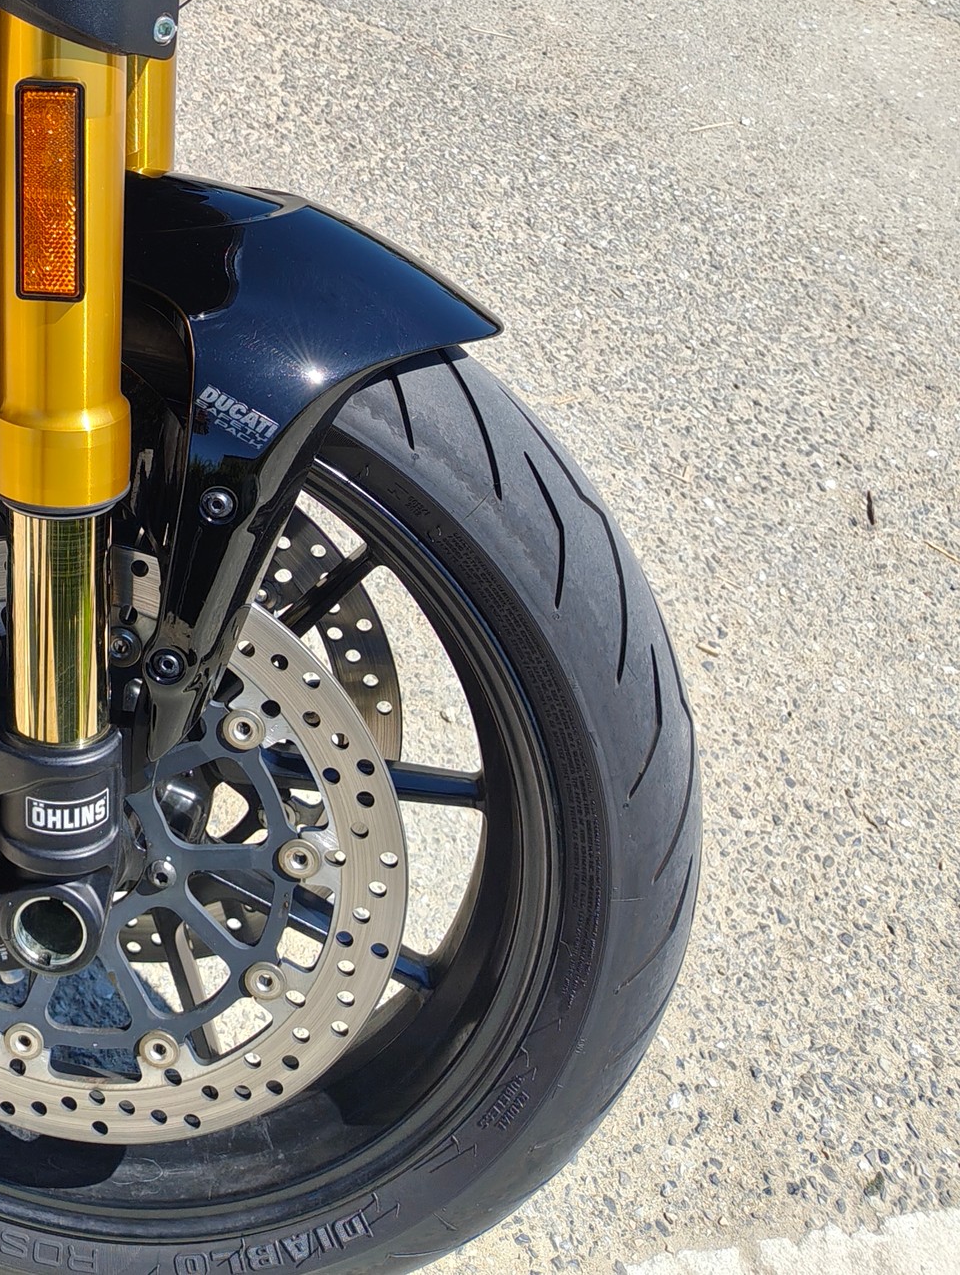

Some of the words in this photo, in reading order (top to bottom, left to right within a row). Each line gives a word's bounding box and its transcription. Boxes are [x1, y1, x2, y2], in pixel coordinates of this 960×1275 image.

[195, 398, 268, 442] SAFETY
[199, 384, 279, 438] DUCATI
[214, 418, 263, 450] PACK
[31, 796, 107, 829] ÖHLINS
[174, 1209, 374, 1275] DIABLO
